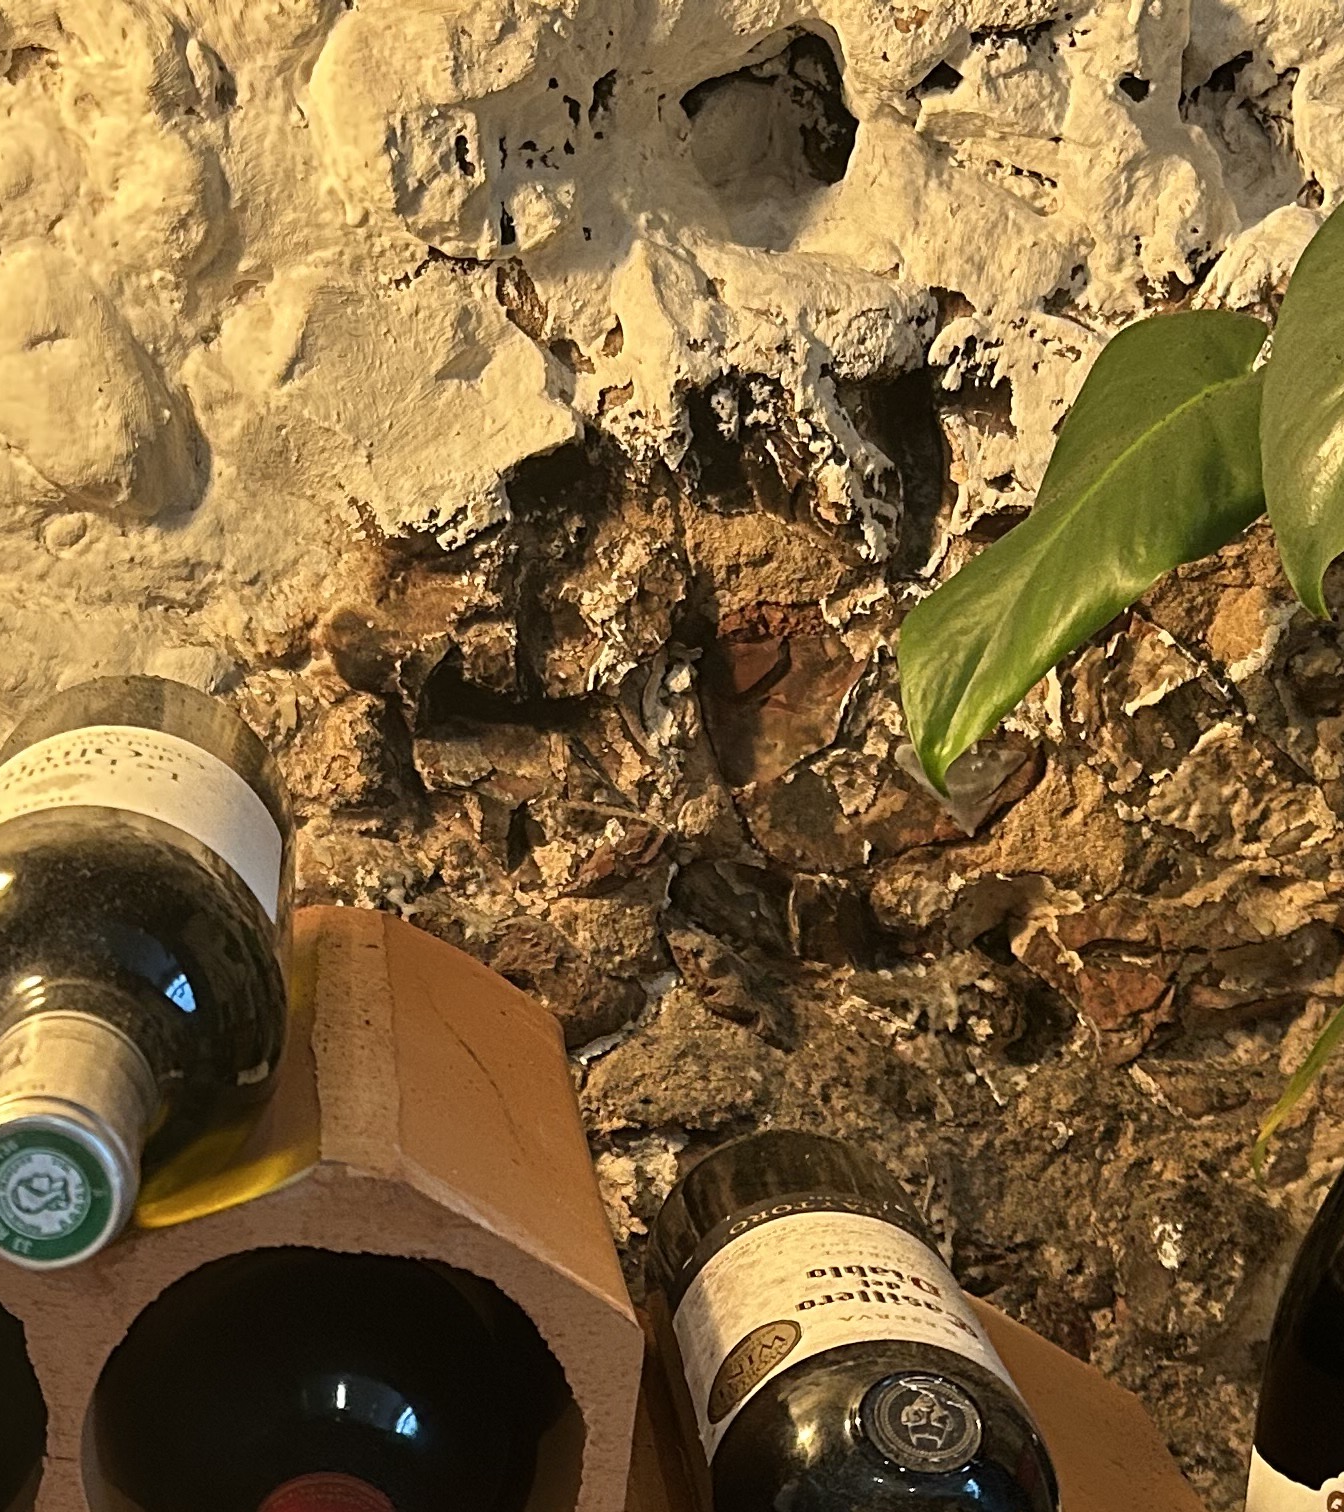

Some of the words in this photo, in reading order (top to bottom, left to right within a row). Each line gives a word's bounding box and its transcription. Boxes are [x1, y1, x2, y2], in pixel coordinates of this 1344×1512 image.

[805, 1264, 943, 1299] Diablo
[858, 1278, 902, 1292] del
[794, 1288, 979, 1340] Casillero
